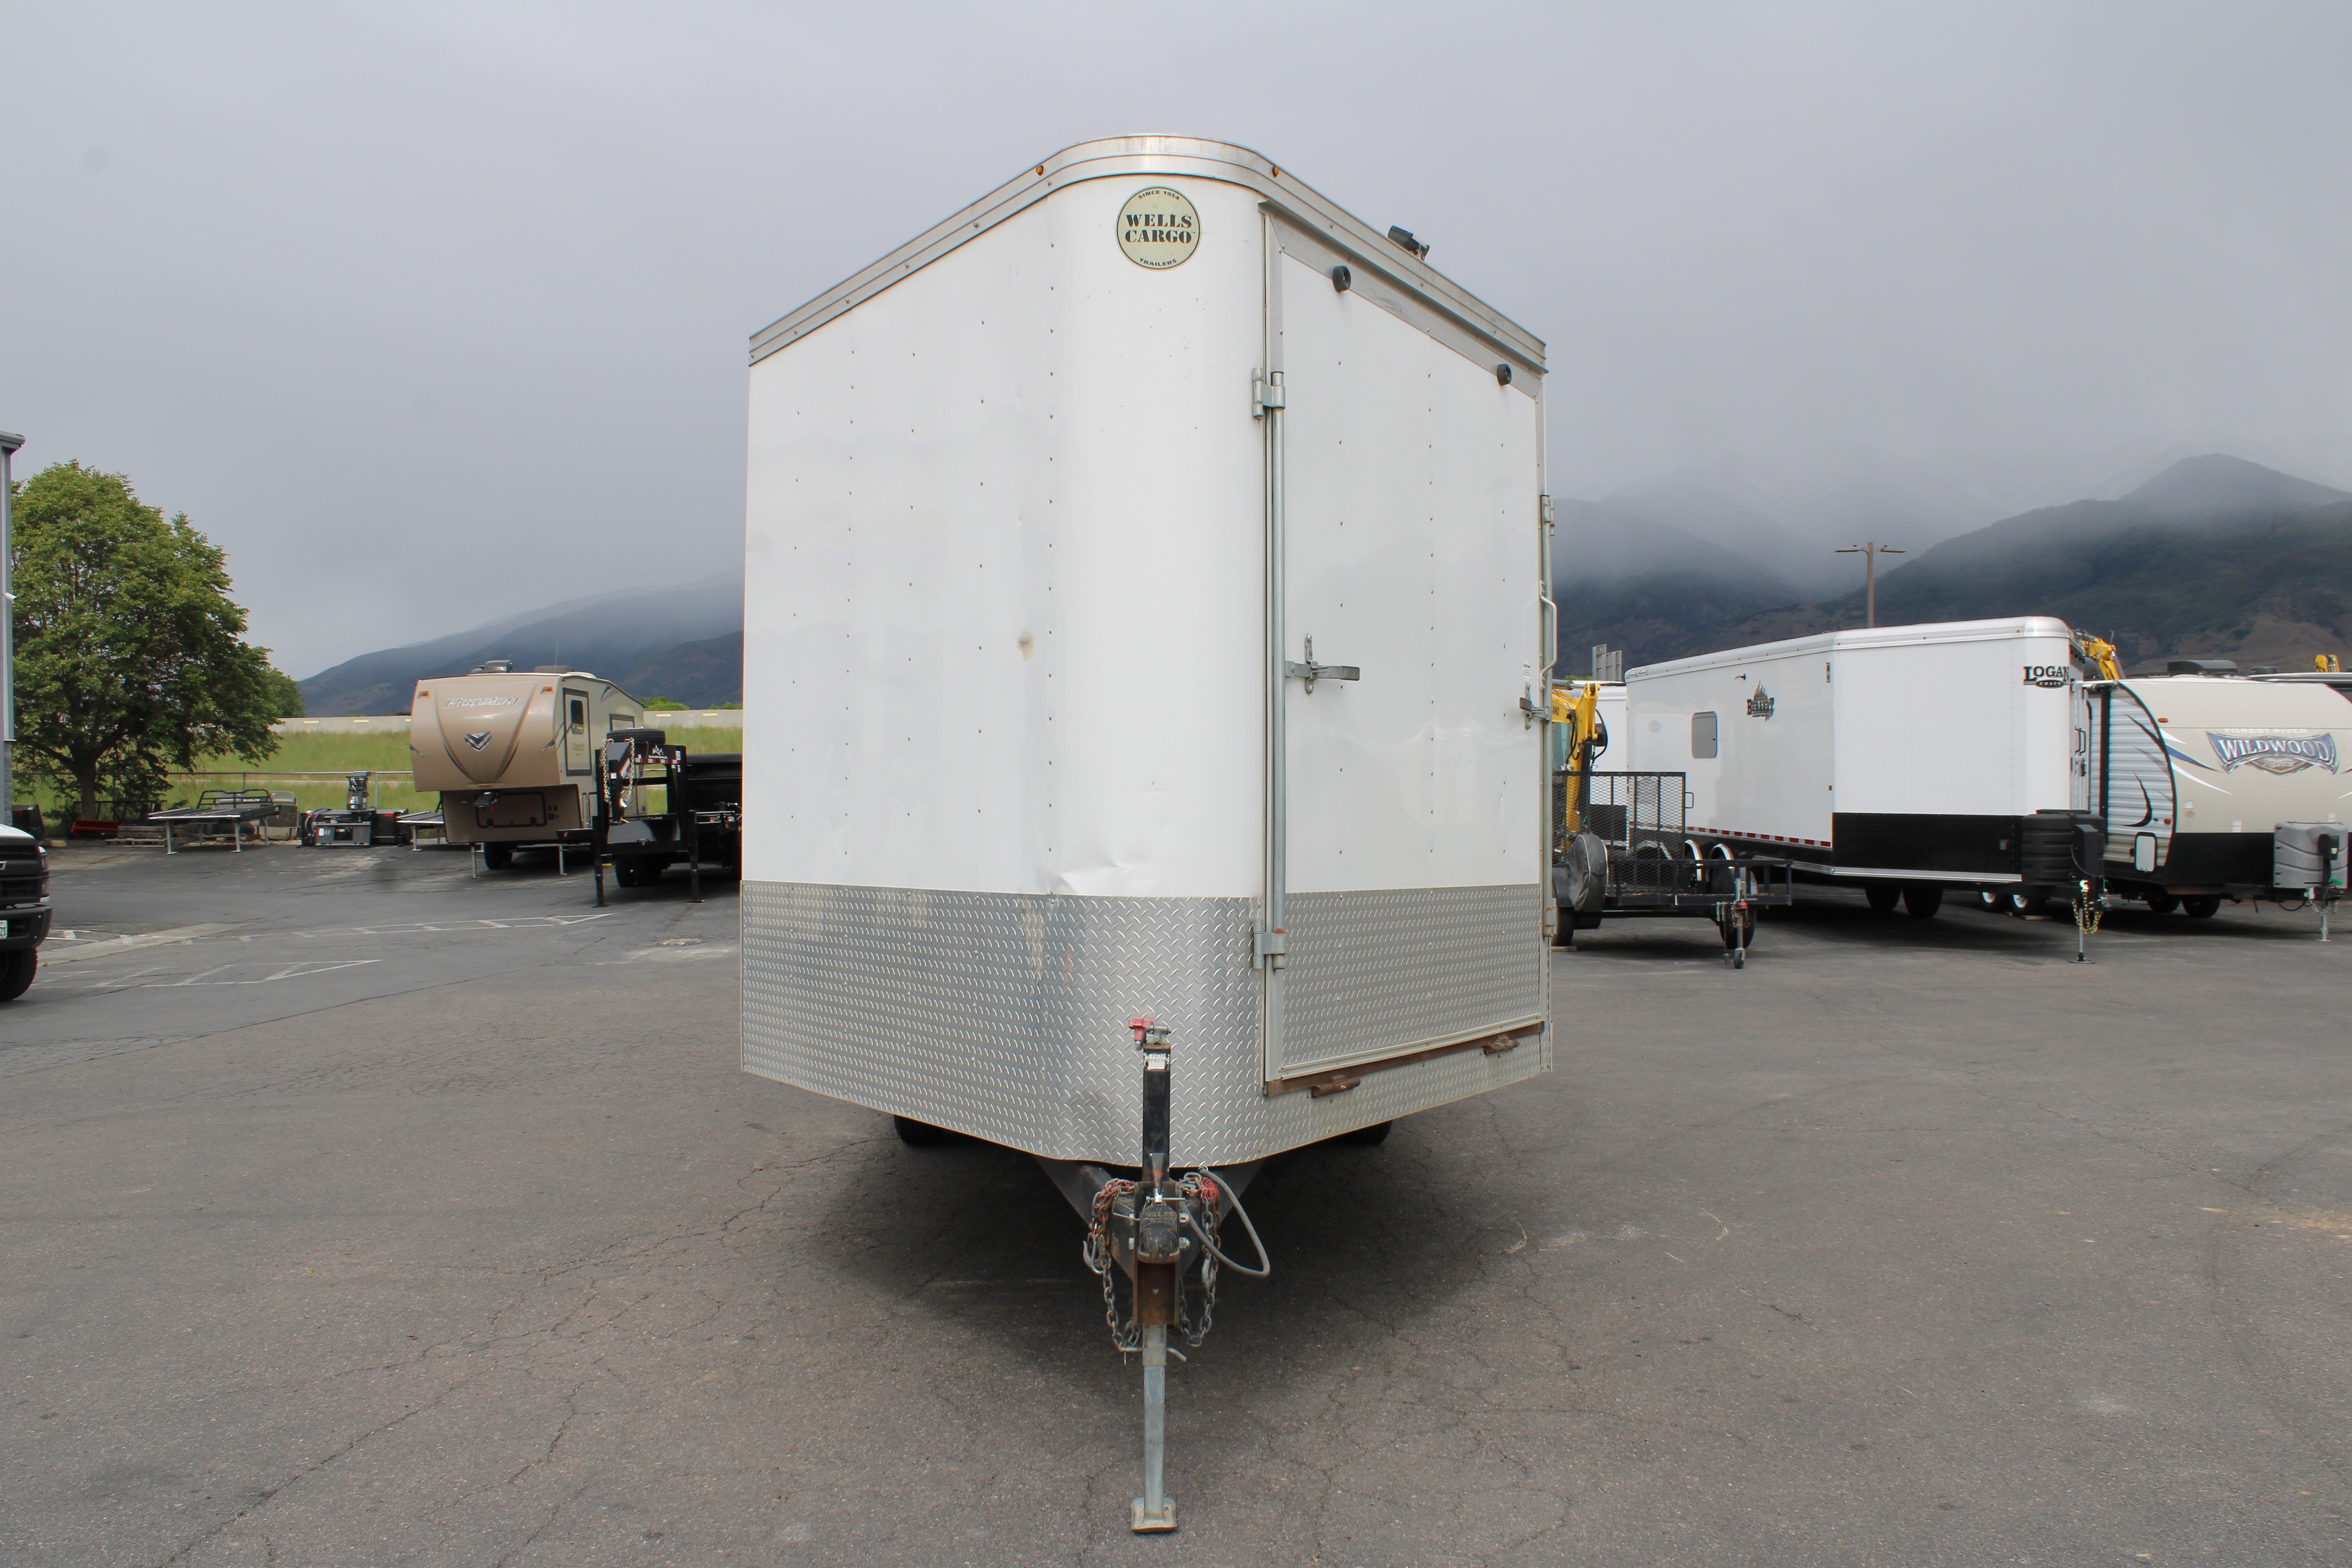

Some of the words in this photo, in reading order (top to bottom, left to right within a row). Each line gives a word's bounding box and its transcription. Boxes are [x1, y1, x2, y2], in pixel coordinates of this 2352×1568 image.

[1138, 190, 1160, 199] SINCE
[1163, 191, 1180, 200] 1954
[1126, 214, 1192, 228] WELLS
[1125, 229, 1192, 244] CARGO
[1139, 258, 1177, 267] TRAILERS
[2023, 666, 2069, 683] LOGAN
[444, 697, 522, 709] Flagstaff
[2218, 739, 2331, 762] WILDWOOD
